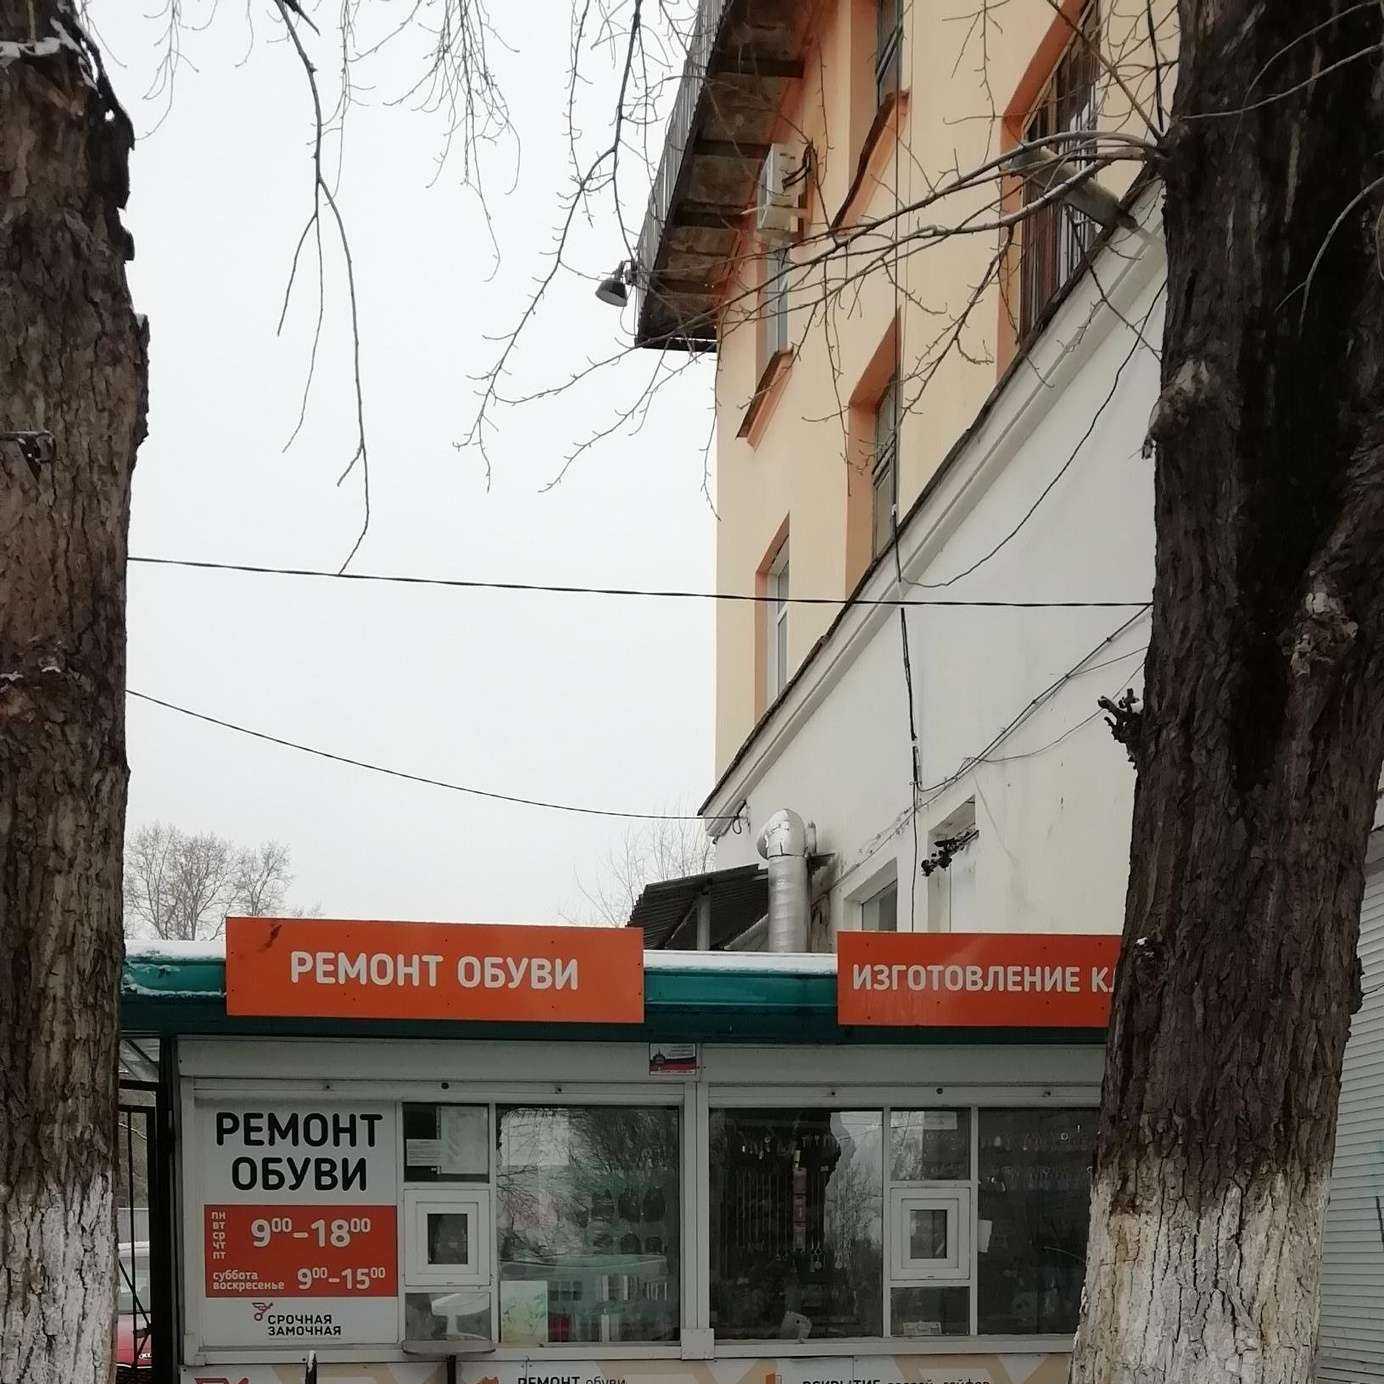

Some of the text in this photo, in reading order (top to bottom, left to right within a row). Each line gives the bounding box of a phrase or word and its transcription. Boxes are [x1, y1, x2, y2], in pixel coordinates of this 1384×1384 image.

[290, 950, 578, 990] РЕМОНТ ОБУВИ
[852, 963, 1081, 993] ИЗГОТОВЛЕНИЕ
[215, 1111, 383, 1147] РЕМОНТ
[231, 1156, 367, 1191] ОБУВИ
[212, 1270, 258, 1283] суббота
[212, 1281, 285, 1292] воскресенье
[267, 1314, 332, 1325] СРОЧНАЯ
[267, 1325, 341, 1336] ЗАМОЧНАЯ
